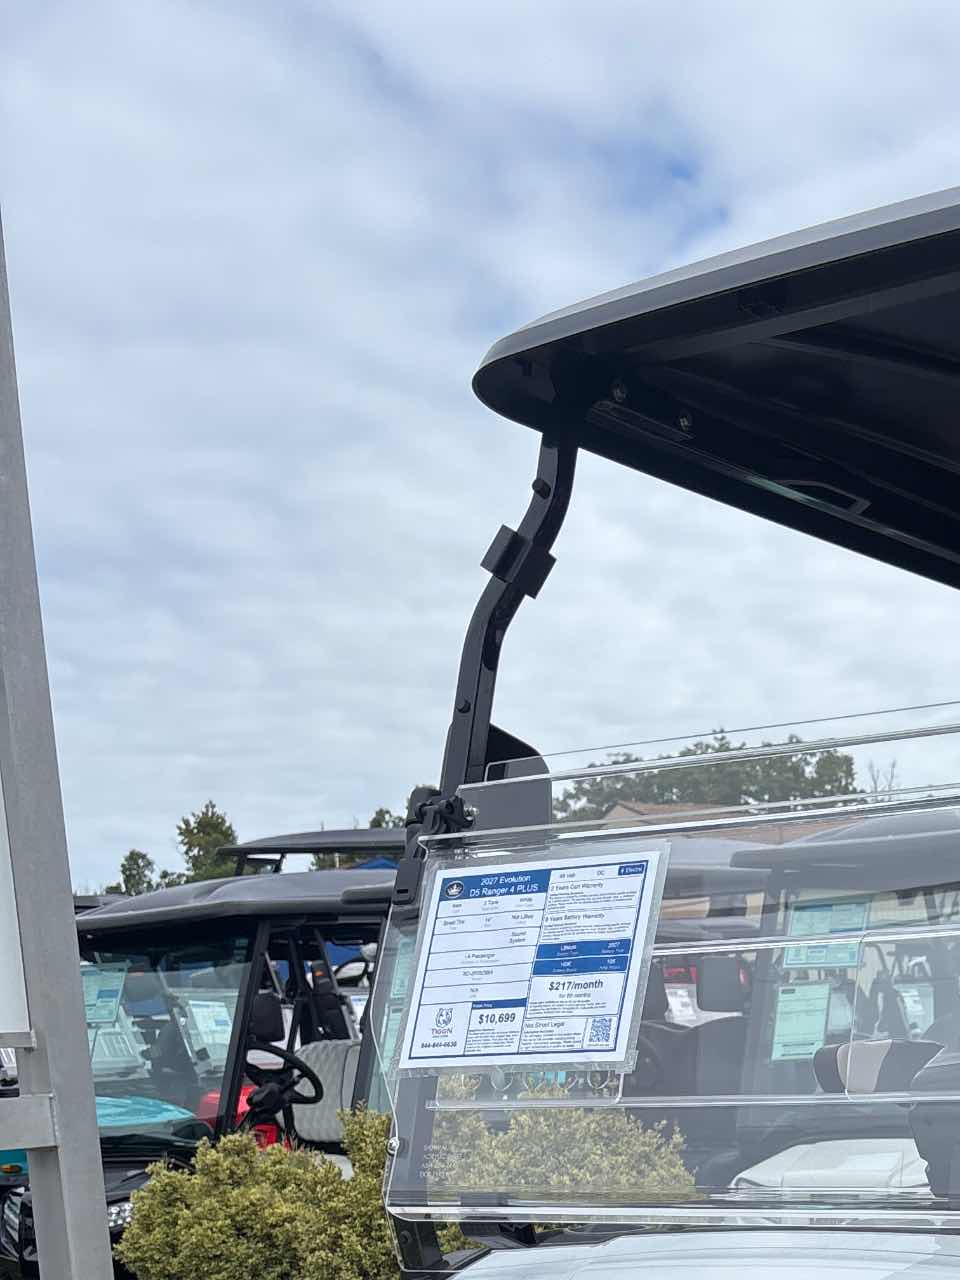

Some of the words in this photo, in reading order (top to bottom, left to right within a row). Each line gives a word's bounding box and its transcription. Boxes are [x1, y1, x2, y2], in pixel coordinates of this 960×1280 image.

[480, 876, 498, 886] 2027
[499, 874, 531, 884] Evolution
[469, 888, 480, 897] D5
[482, 886, 508, 897] Ranger
[509, 884, 515, 893] 4
[516, 883, 539, 893] PLUS
[548, 978, 604, 992] $217/month
[478, 1012, 516, 1025] $10,699
